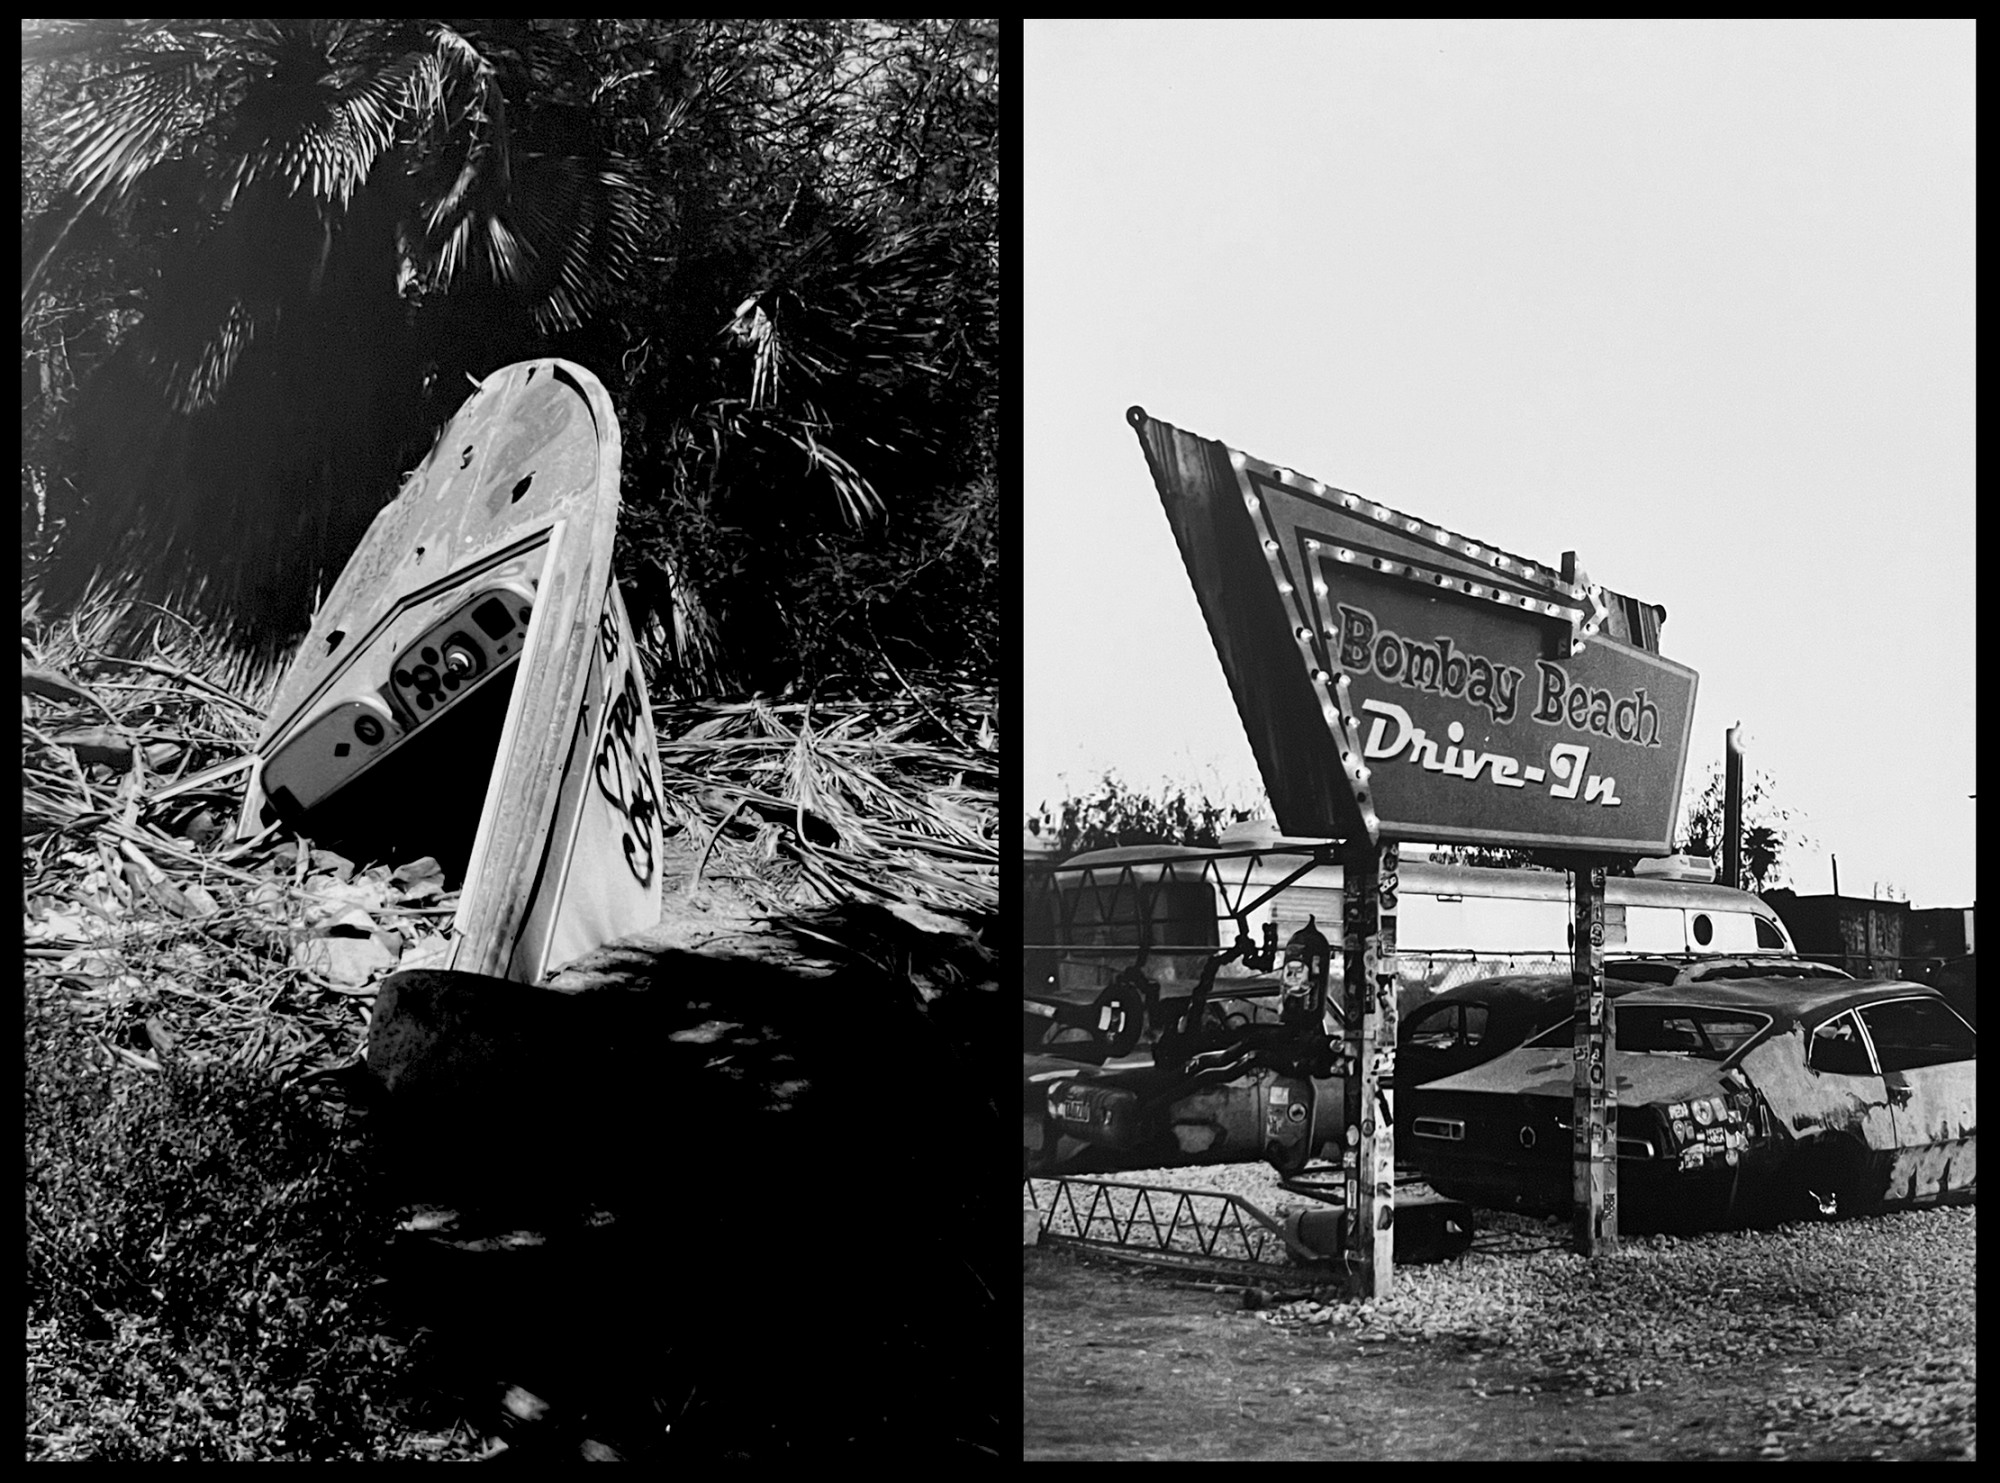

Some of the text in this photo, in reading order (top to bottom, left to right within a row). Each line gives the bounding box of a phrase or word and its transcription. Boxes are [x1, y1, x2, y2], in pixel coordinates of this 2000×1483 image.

[1337, 602, 1661, 748] Bombay Beach
[1361, 698, 1621, 806] Drive-In
